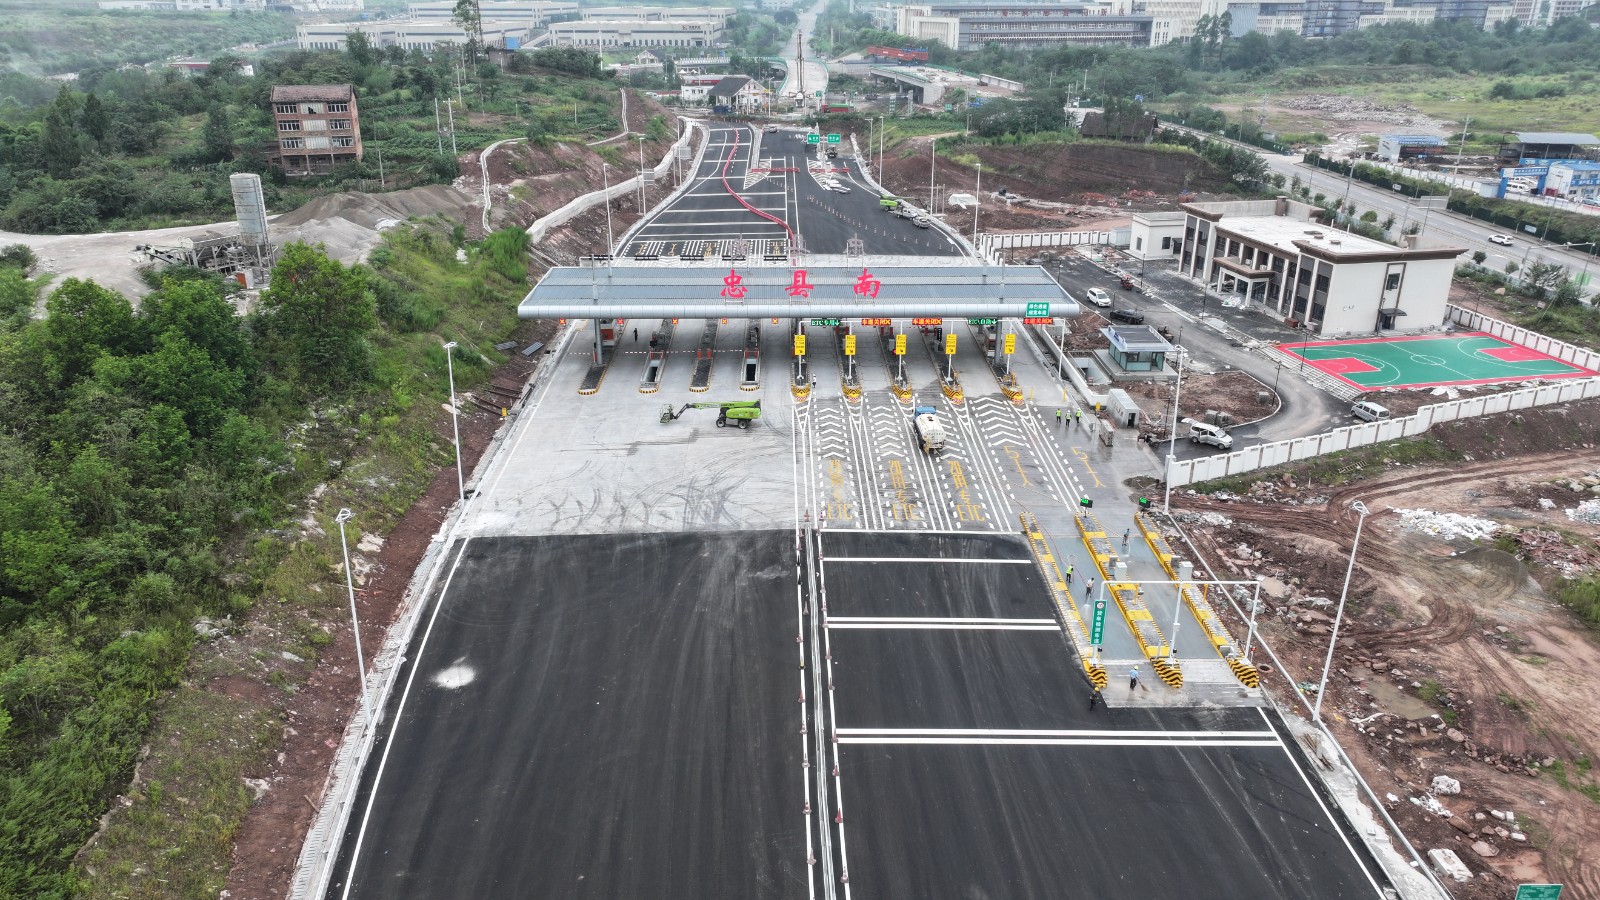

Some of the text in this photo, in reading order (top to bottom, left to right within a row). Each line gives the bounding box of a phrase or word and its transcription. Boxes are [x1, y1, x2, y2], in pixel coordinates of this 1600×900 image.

[720, 268, 881, 299] 忠县南
[956, 504, 985, 522] ETC
